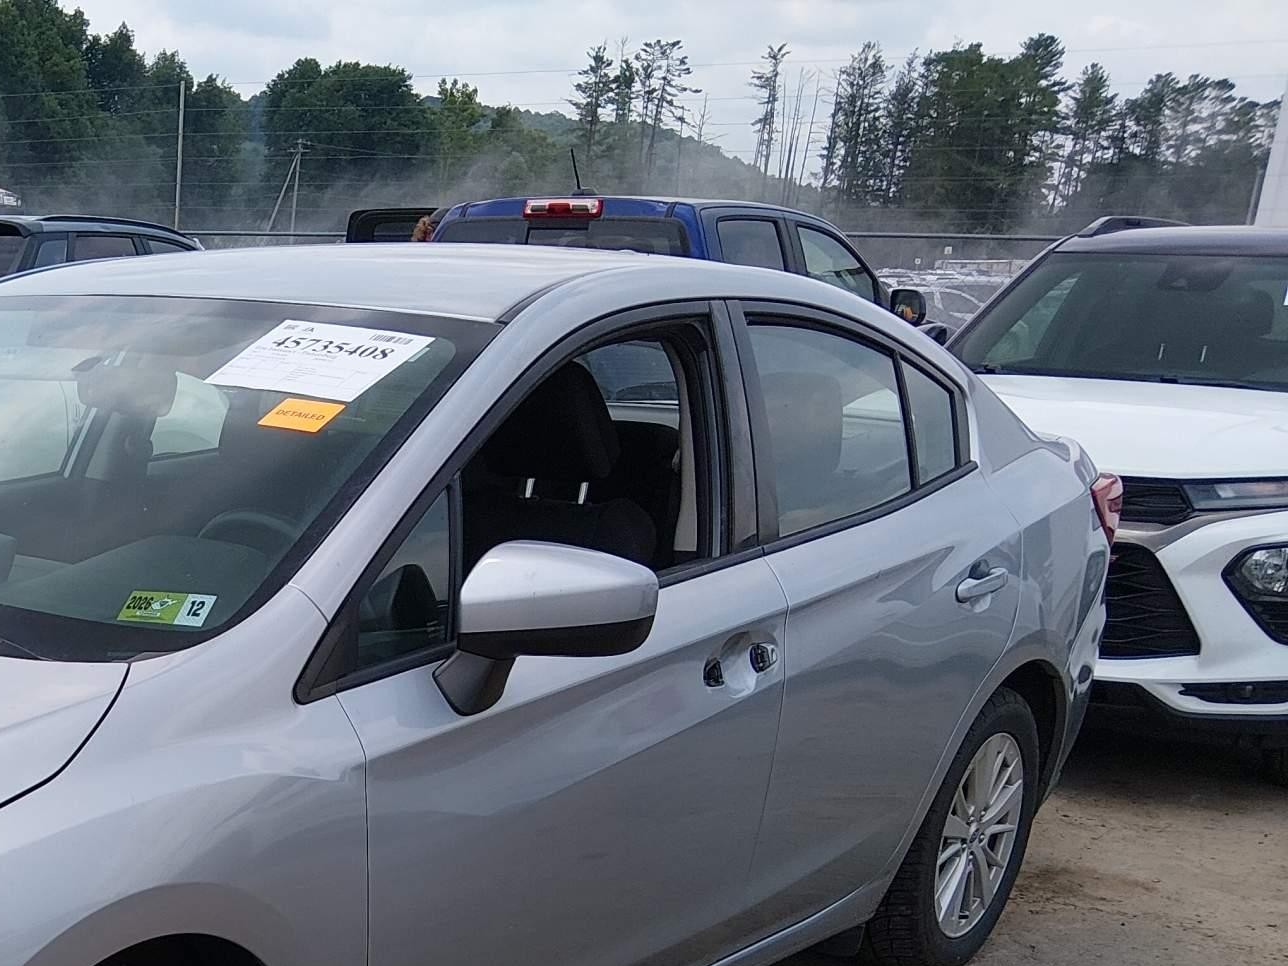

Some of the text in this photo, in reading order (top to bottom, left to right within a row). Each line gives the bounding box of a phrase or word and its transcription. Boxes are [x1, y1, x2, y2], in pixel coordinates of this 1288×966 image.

[272, 335, 395, 361] 45735408
[275, 409, 326, 421] DETAILED
[125, 596, 155, 611] 2026
[186, 600, 206, 617] 12
